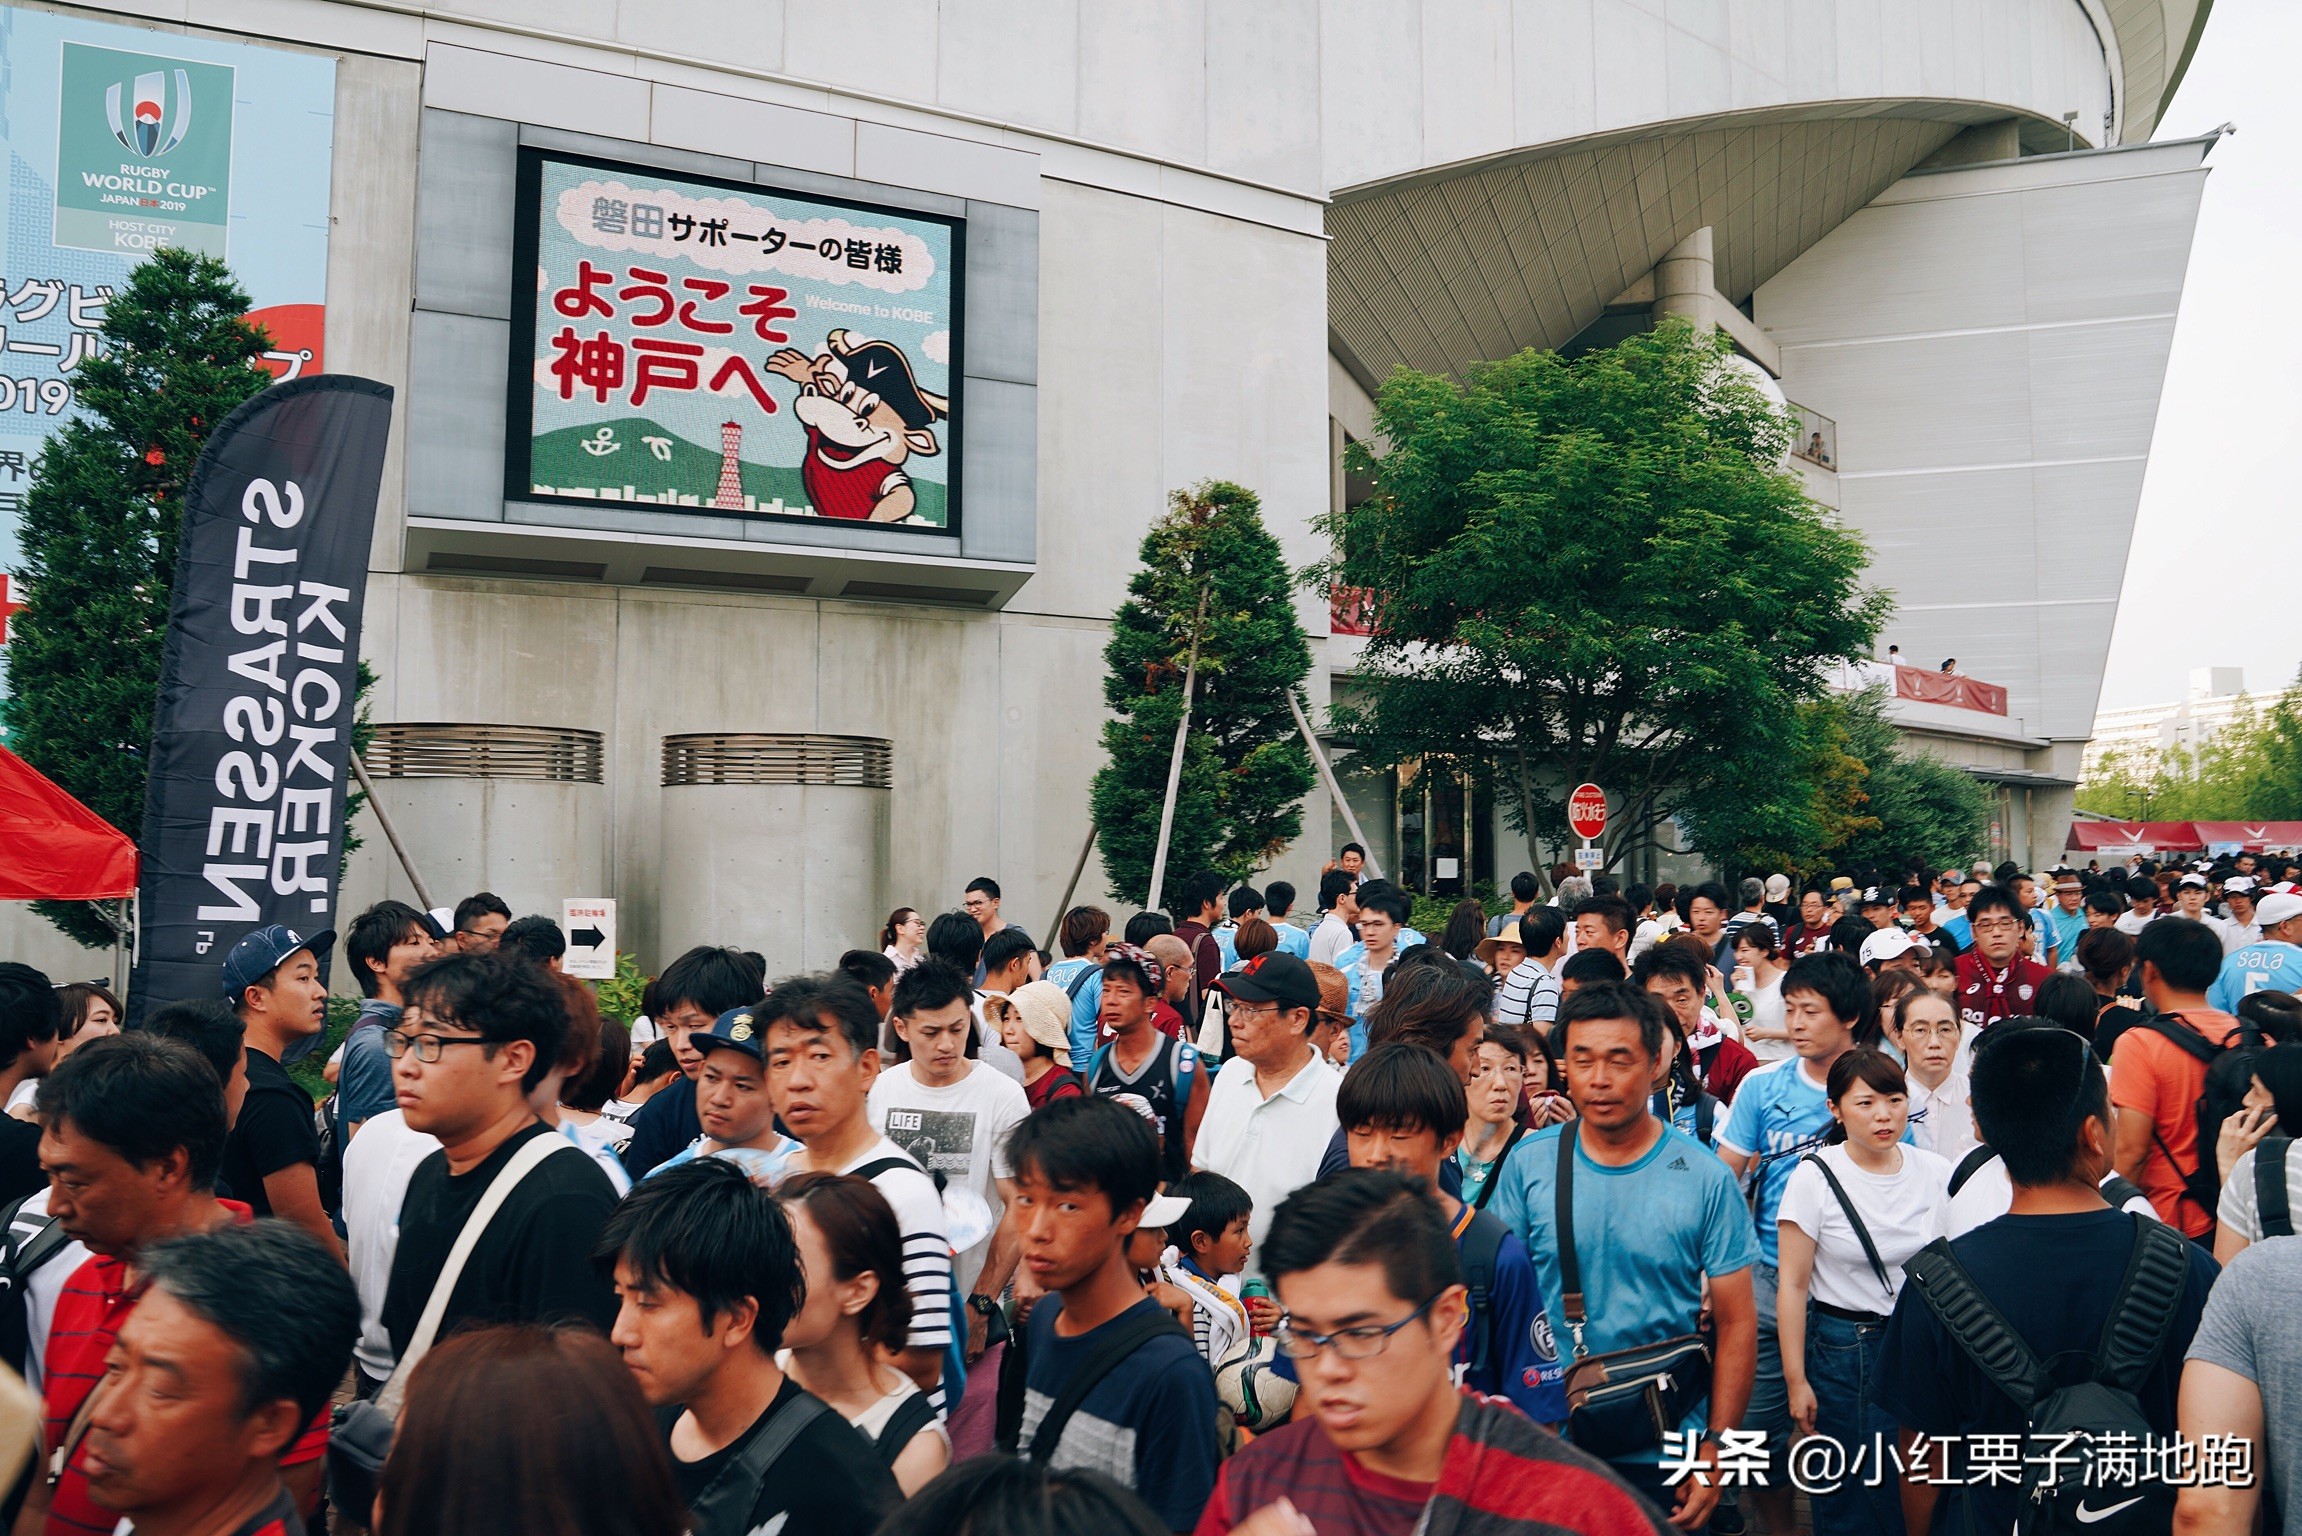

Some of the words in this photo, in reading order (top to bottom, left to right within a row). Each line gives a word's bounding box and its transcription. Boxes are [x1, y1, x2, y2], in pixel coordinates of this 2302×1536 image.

[120, 163, 171, 180] RUGBY
[81, 171, 163, 195] WORLD
[100, 193, 140, 207] JAPAN
[159, 201, 187, 212] 2019
[109, 219, 145, 233] HOST
[147, 223, 177, 236] CITY
[592, 196, 903, 275] 磐田サポーターの皆様
[114, 232, 170, 250] KOBE
[0, 277, 115, 329] グビ
[552, 260, 797, 344] ようこそ
[805, 294, 872, 316] Welcome
[874, 304, 890, 317] to
[892, 306, 934, 325] KOBE
[550, 327, 778, 414] 神戸へ
[2237, 951, 2285, 970] sala
[891, 1113, 920, 1129] LIFE
